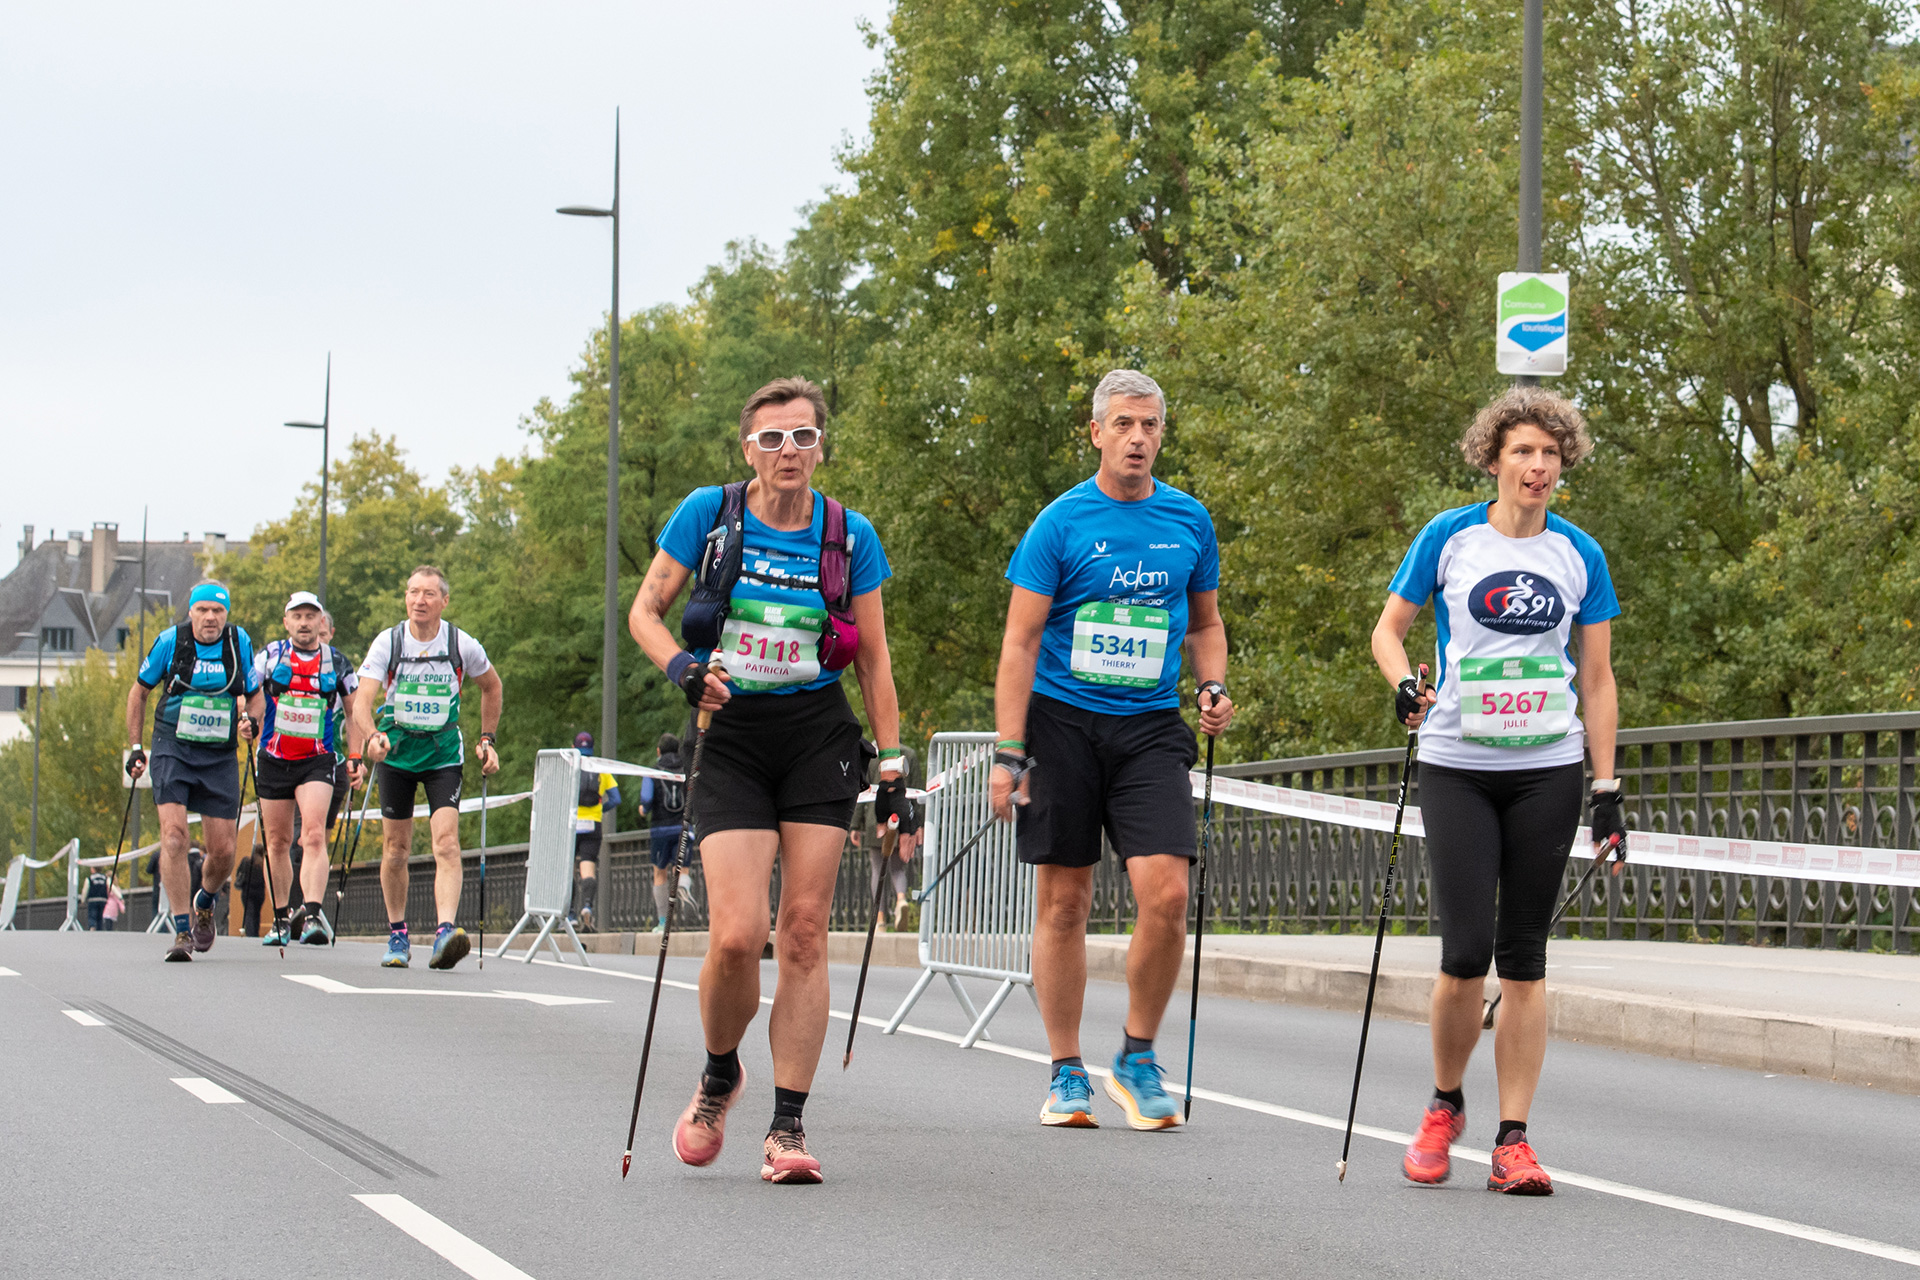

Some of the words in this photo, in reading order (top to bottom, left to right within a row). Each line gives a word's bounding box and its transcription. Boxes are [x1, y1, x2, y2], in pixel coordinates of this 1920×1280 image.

[1504, 299, 1546, 309] Commune
[1521, 323, 1564, 334] touristique
[1527, 594, 1555, 617] 91
[736, 632, 801, 663] 5118
[1091, 633, 1148, 658] 5341
[745, 662, 789, 675] PATRICIA
[1102, 659, 1137, 669] THIERRY
[423, 674, 452, 682] SPORTS
[404, 701, 440, 714] 5183
[1482, 690, 1548, 715] 5267
[188, 713, 222, 727] 5001
[282, 710, 312, 724] 5393
[1503, 719, 1528, 730] JULIE
